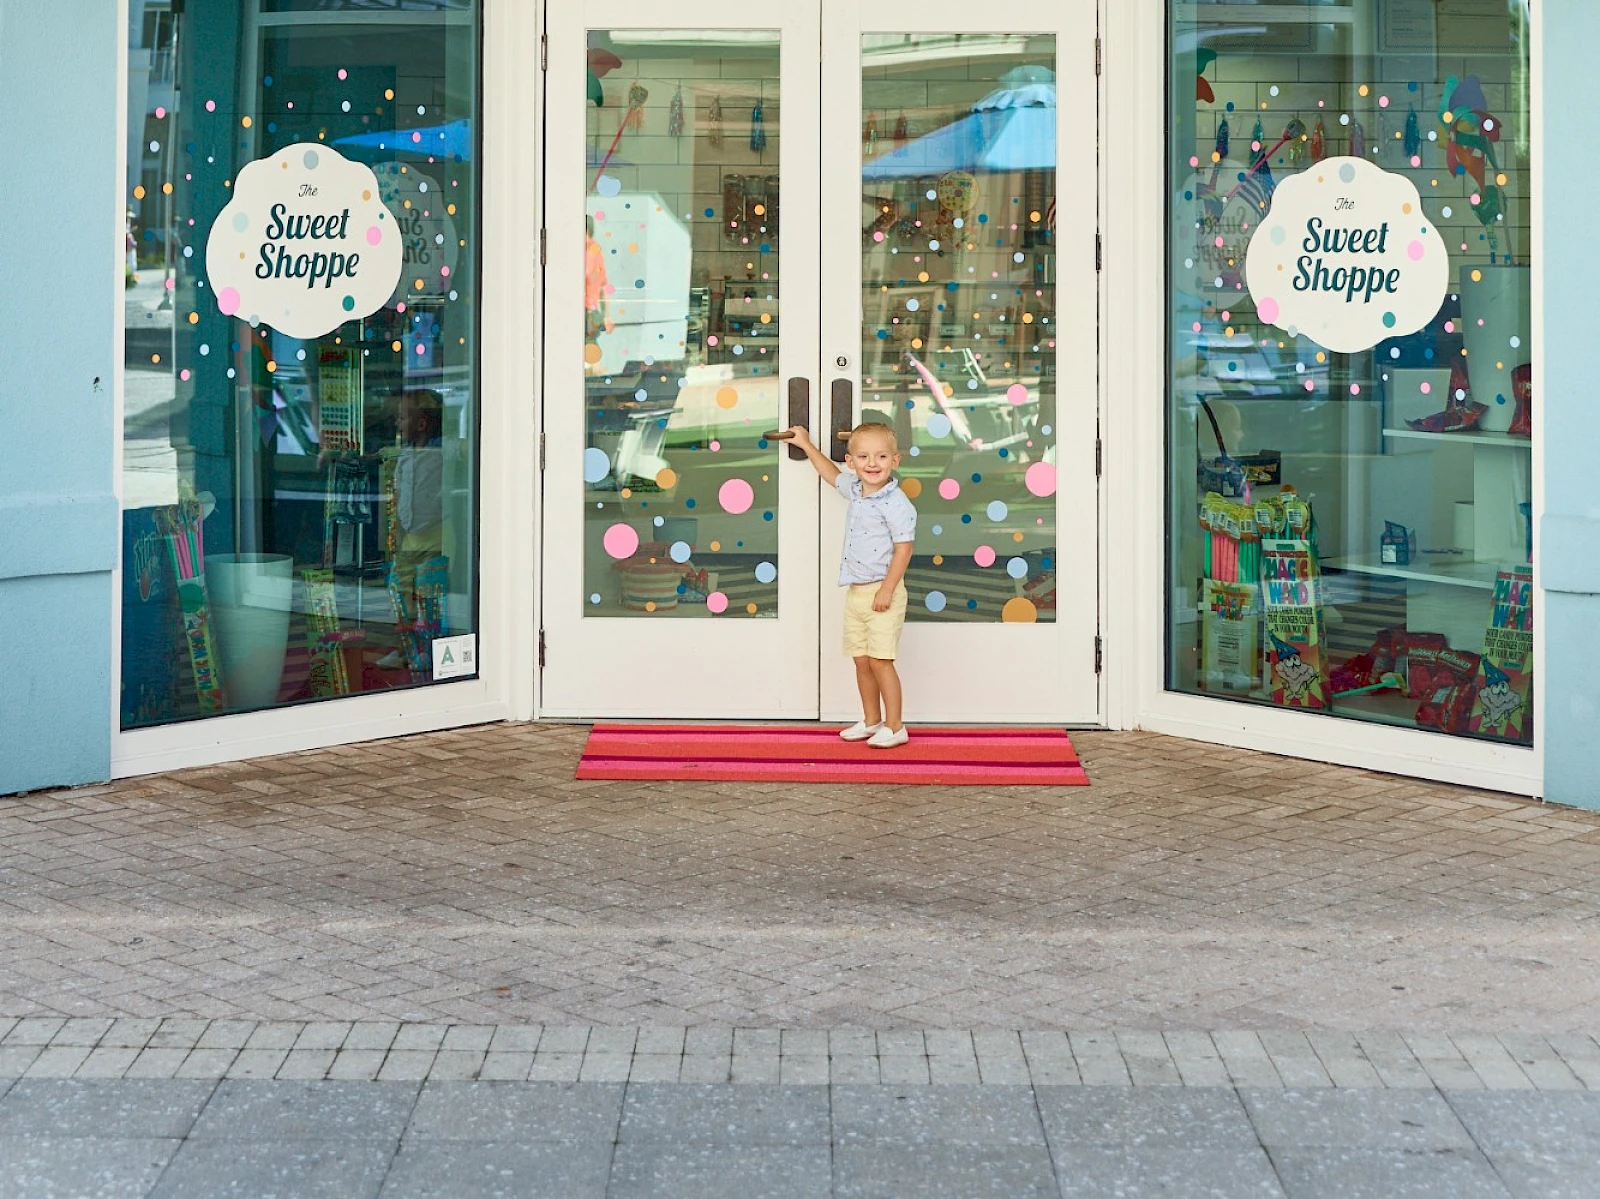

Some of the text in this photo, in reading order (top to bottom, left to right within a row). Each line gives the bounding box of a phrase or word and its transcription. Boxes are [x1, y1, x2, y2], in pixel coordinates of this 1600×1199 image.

[298, 184, 318, 197] The
[1334, 197, 1355, 211] The
[266, 203, 350, 240] Sweet
[1303, 217, 1389, 253] Sweet
[255, 243, 360, 289] Shoppe
[1292, 255, 1400, 304] Shoppe
[1263, 557, 1309, 581] MAGIC
[1268, 581, 1309, 605] WAND
[441, 645, 455, 665] A
